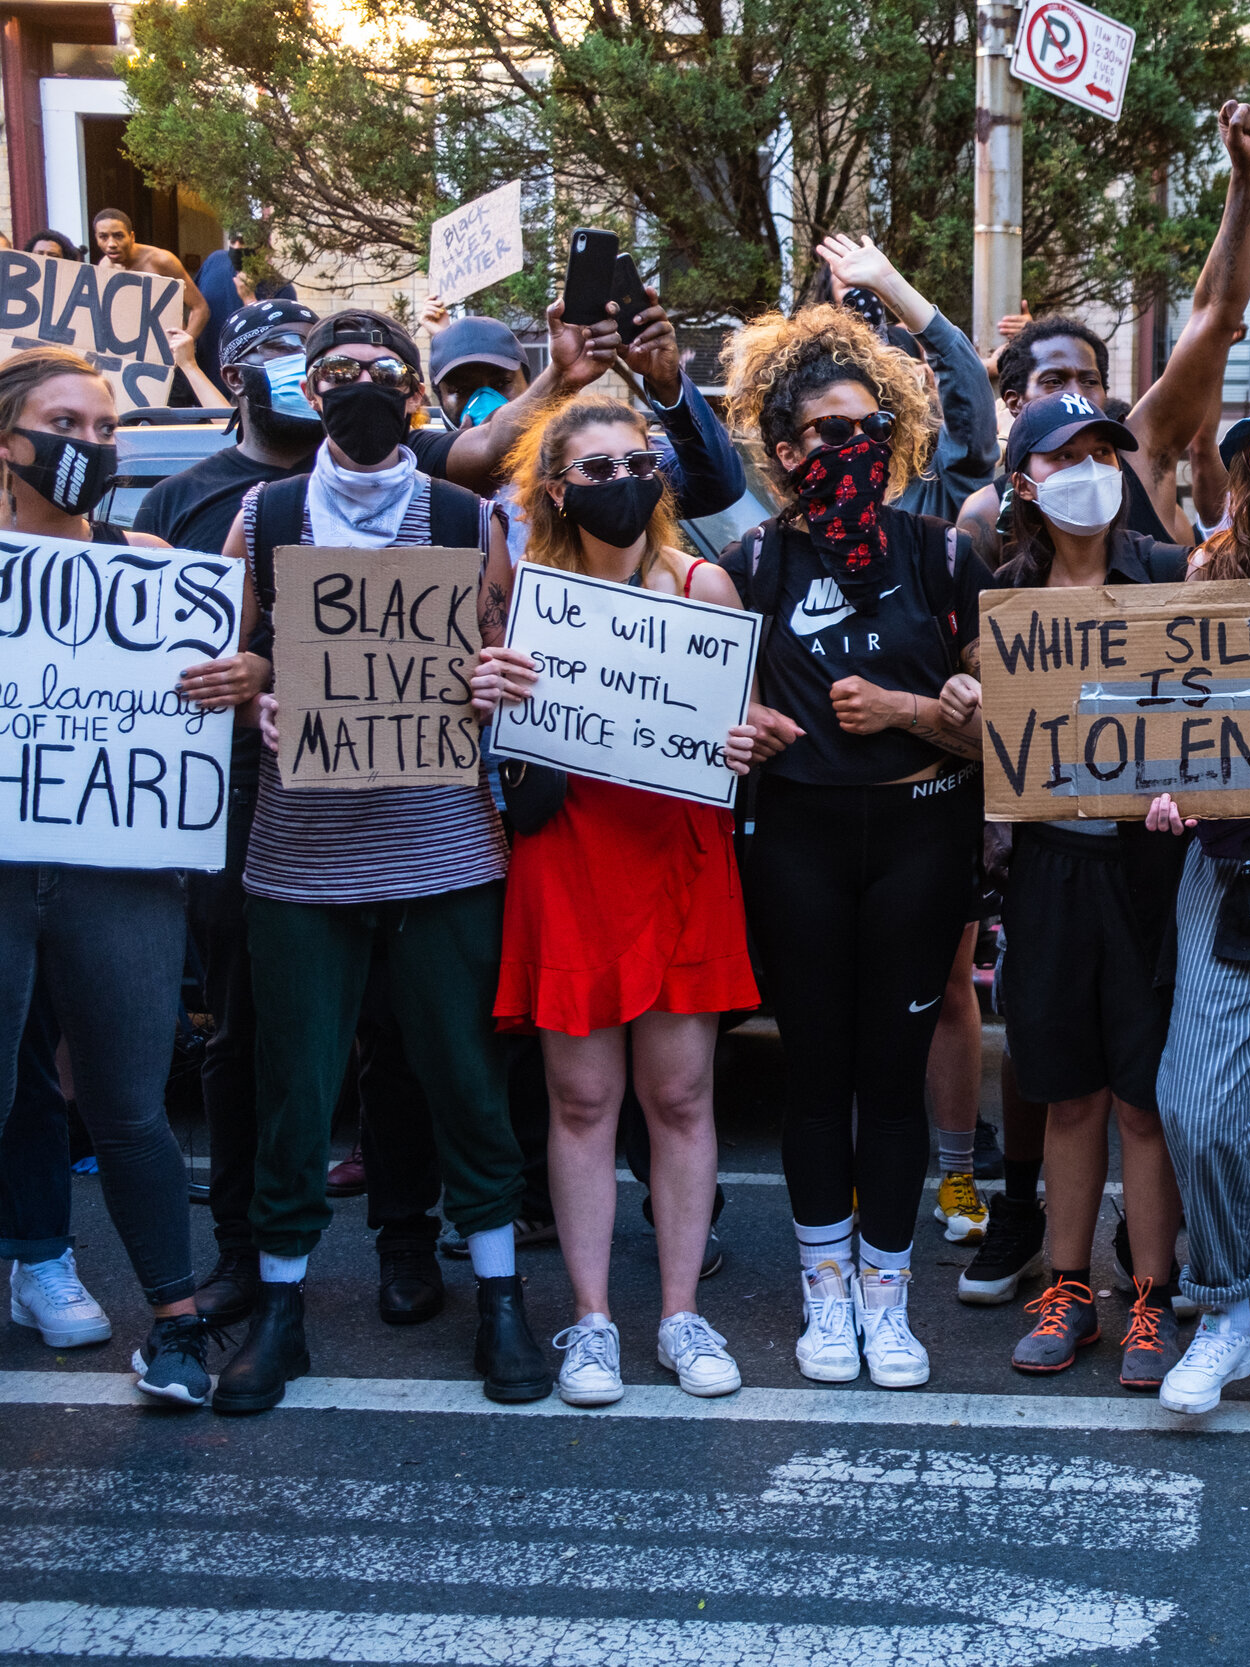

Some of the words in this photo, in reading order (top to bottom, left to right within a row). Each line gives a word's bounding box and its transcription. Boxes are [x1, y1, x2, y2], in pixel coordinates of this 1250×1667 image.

[439, 237, 511, 298] MATTER
[0, 250, 180, 366] BLACK
[313, 572, 475, 655] BLACK
[535, 583, 587, 629] We
[611, 615, 667, 655] will
[686, 633, 740, 667] NOT
[529, 650, 588, 684] STOP
[811, 632, 882, 656] AIR
[986, 610, 1129, 676] WHITE
[0, 681, 22, 709] e
[324, 651, 473, 705] LIVES
[1135, 666, 1213, 708] IS
[12, 713, 47, 739] OF
[55, 715, 109, 741] THE
[292, 710, 478, 774] MATTERS
[632, 718, 656, 748] is
[660, 734, 736, 771] serve
[912, 774, 957, 799] NIKE
